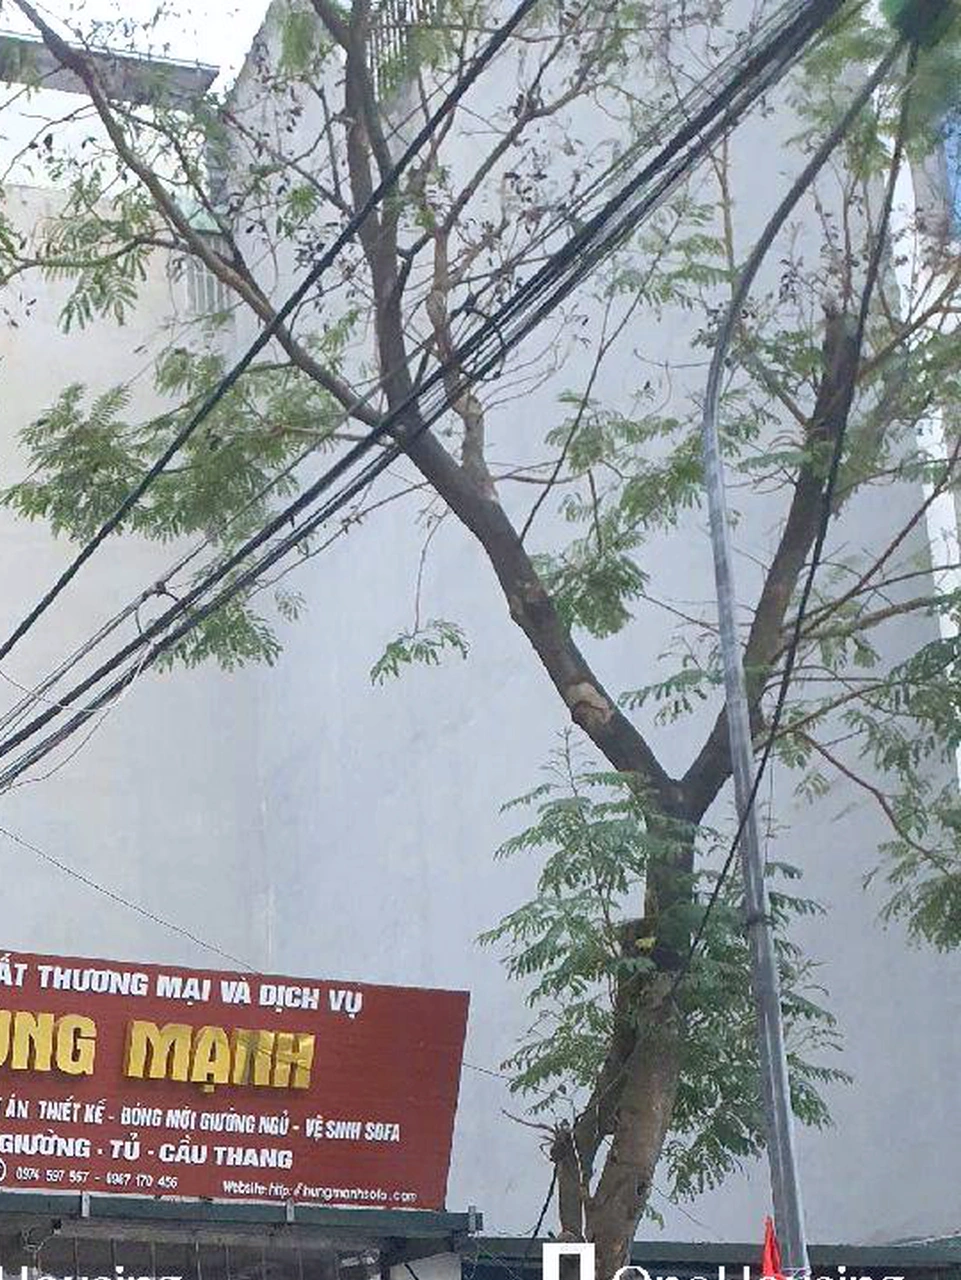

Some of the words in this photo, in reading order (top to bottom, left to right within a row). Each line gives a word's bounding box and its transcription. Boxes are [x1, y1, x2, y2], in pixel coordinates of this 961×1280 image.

[38, 964, 149, 997] THƯƠNG
[156, 974, 212, 1006] MẠI
[220, 976, 251, 1004] VÀ
[260, 984, 320, 1012] DỊCH
[329, 989, 362, 1018] VỤ
[123, 1019, 316, 1093] MẠNH
[5, 1093, 29, 1118] ÁN
[38, 1095, 81, 1123] THIẾT
[166, 1106, 197, 1130] MỚI
[200, 1107, 255, 1134] GIƯỜNG
[258, 1109, 289, 1136] NGỦ
[305, 1115, 324, 1142] VỆ
[326, 1120, 362, 1141] SINH
[365, 1122, 401, 1142] SOFA
[109, 1132, 140, 1160] TỦ
[158, 1135, 208, 1164] CẦU
[213, 1146, 293, 1170] THANG
